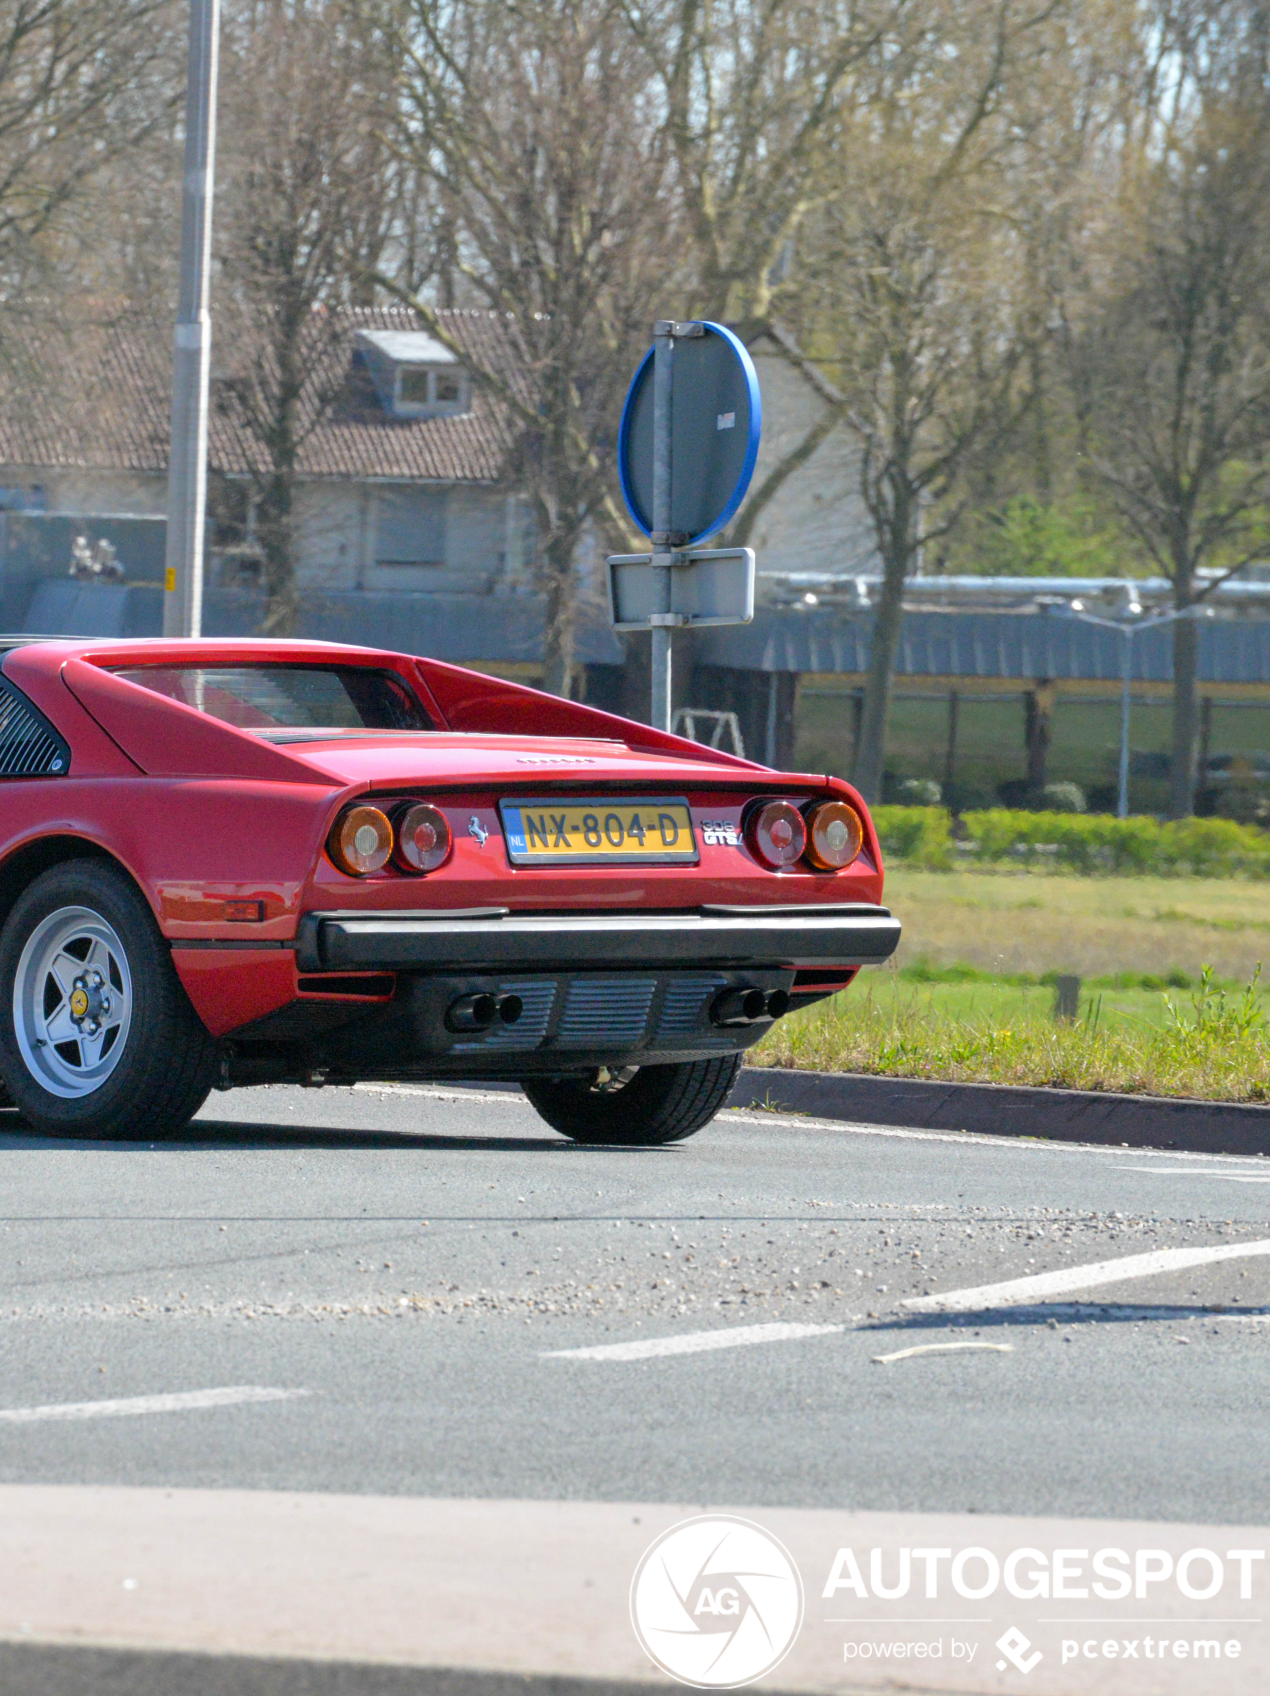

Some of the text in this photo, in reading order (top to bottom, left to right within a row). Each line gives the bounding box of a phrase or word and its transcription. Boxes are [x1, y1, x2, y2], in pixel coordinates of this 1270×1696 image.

[526, 812, 679, 848] NX-804-D
[700, 819, 735, 832] 308
[510, 835, 525, 847] NL
